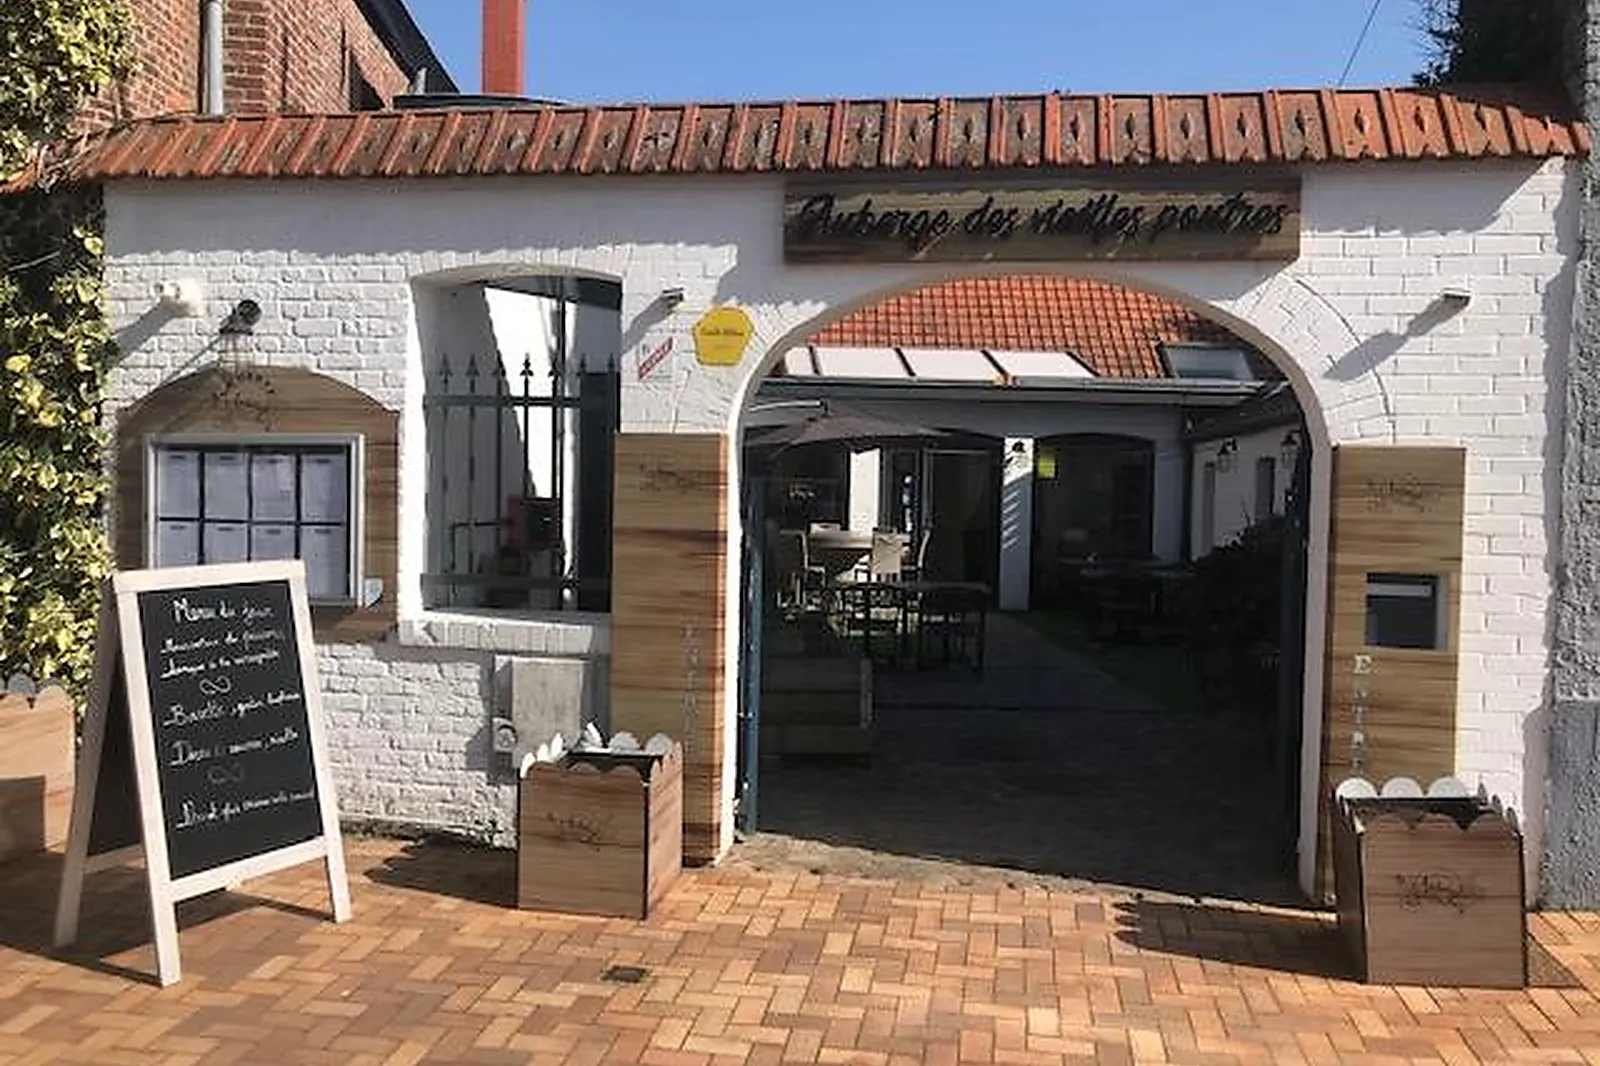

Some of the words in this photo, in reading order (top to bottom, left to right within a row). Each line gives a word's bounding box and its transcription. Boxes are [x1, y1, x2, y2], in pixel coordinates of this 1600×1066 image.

[800, 195, 953, 252] Auberge
[964, 197, 1019, 236] des
[1030, 194, 1144, 236] vieilles
[1149, 192, 1288, 244] poutres
[173, 598, 216, 622] Menu
